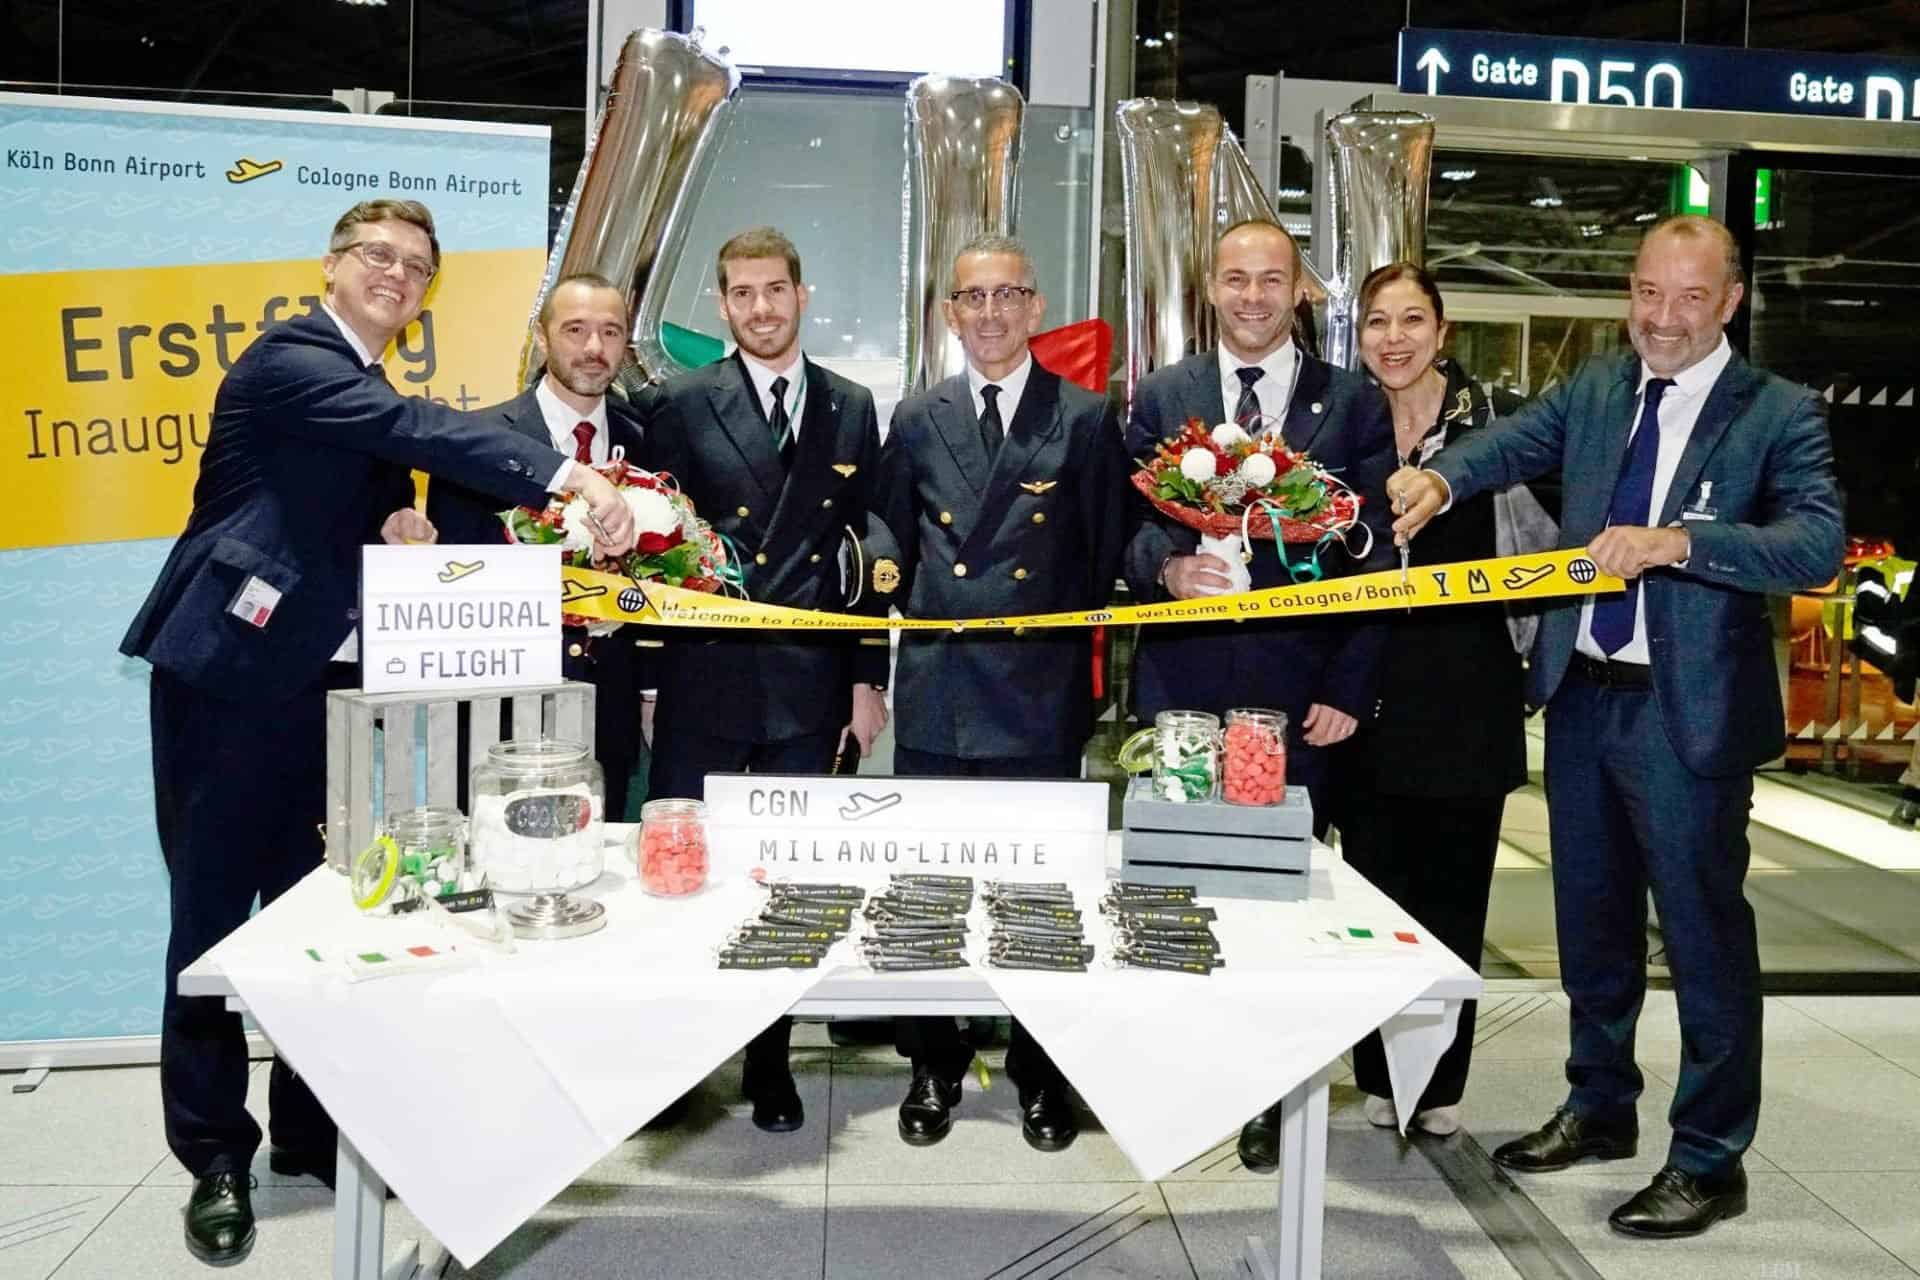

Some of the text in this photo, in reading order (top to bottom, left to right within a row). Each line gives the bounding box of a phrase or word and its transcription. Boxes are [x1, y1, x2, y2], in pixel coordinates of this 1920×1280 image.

[1471, 53, 1538, 86] Gate
[1790, 72, 1854, 104] Gate
[7, 149, 206, 181] Köln Bonn Airport
[297, 166, 522, 198] Cologne Bonn Airport
[24, 409, 213, 464] Inaugu
[377, 601, 551, 631] INAUGURAL
[662, 600, 751, 623] Welcome
[761, 616, 782, 625] to
[1136, 583, 1417, 618] Welcome to Cologne/Bonn
[420, 649, 526, 679] FLIGHT
[748, 789, 809, 817] CGN
[759, 839, 1046, 865] MILANO-LINATE
